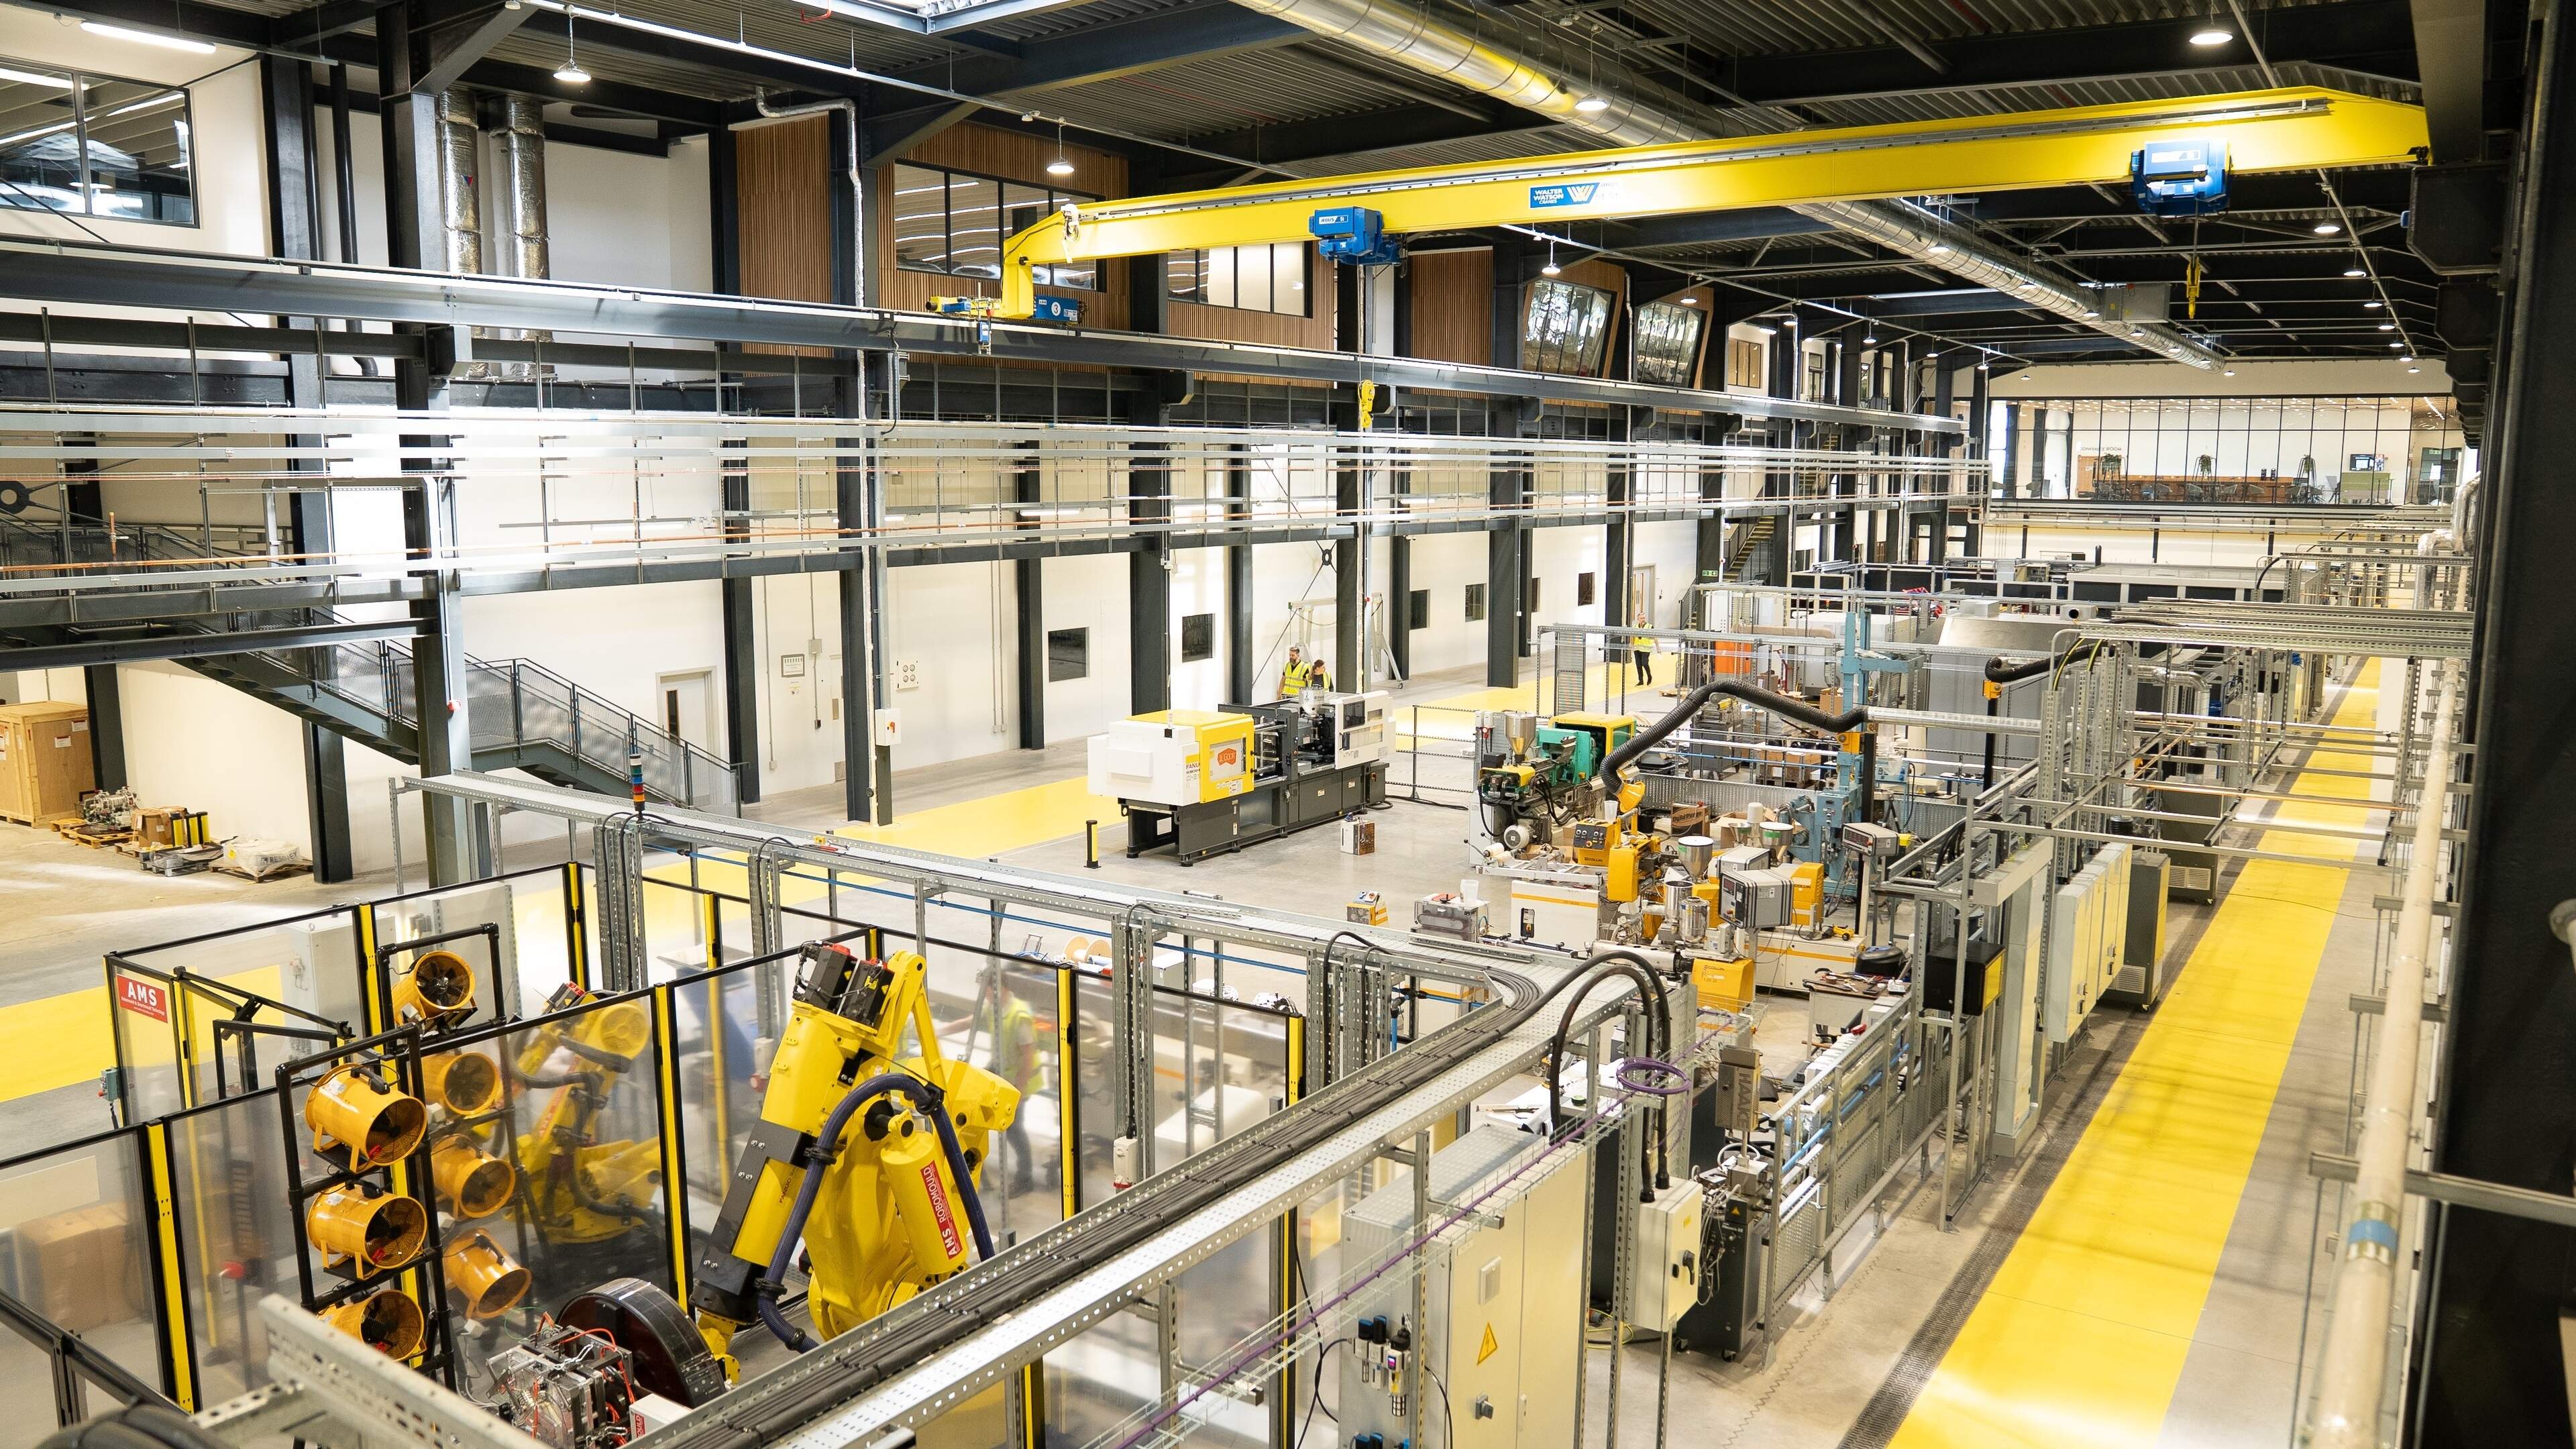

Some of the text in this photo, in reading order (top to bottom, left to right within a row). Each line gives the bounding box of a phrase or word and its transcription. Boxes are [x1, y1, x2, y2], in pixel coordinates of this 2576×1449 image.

[1054, 304, 1059, 314] 3
[128, 981, 158, 1007] AMS
[1738, 1073, 1752, 1128] HAAKE
[780, 1177, 792, 1203] FANUC
[923, 1167, 947, 1224] ROBOMOULD
[942, 1228, 957, 1256] AMS
